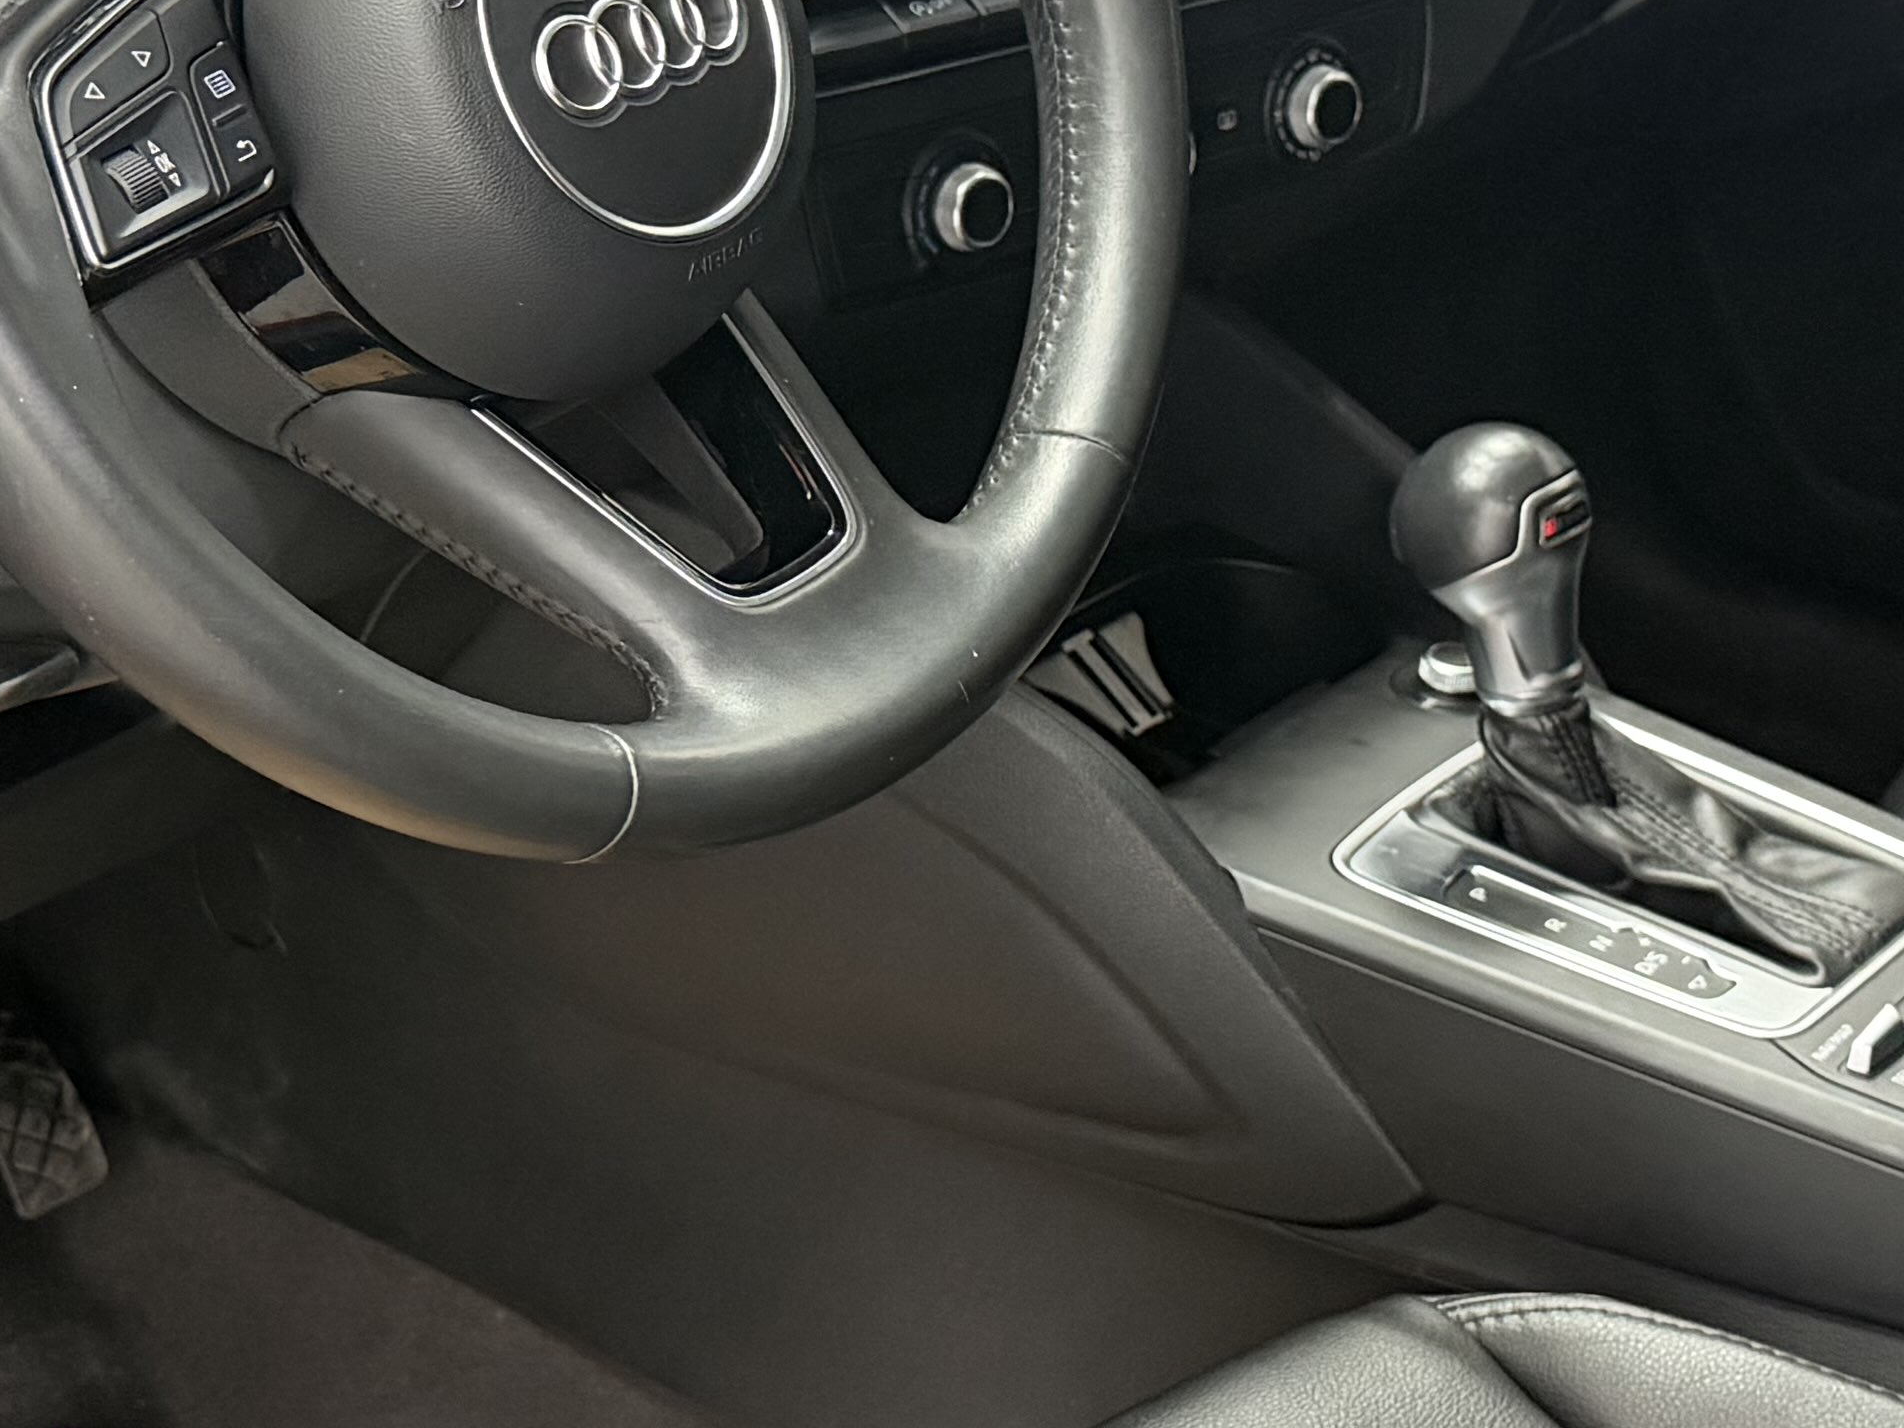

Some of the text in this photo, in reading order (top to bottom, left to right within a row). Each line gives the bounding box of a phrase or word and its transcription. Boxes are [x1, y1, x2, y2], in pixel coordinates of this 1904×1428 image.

[1469, 887, 1487, 902] P
[1544, 918, 1567, 933] R
[1589, 934, 1613, 952] N
